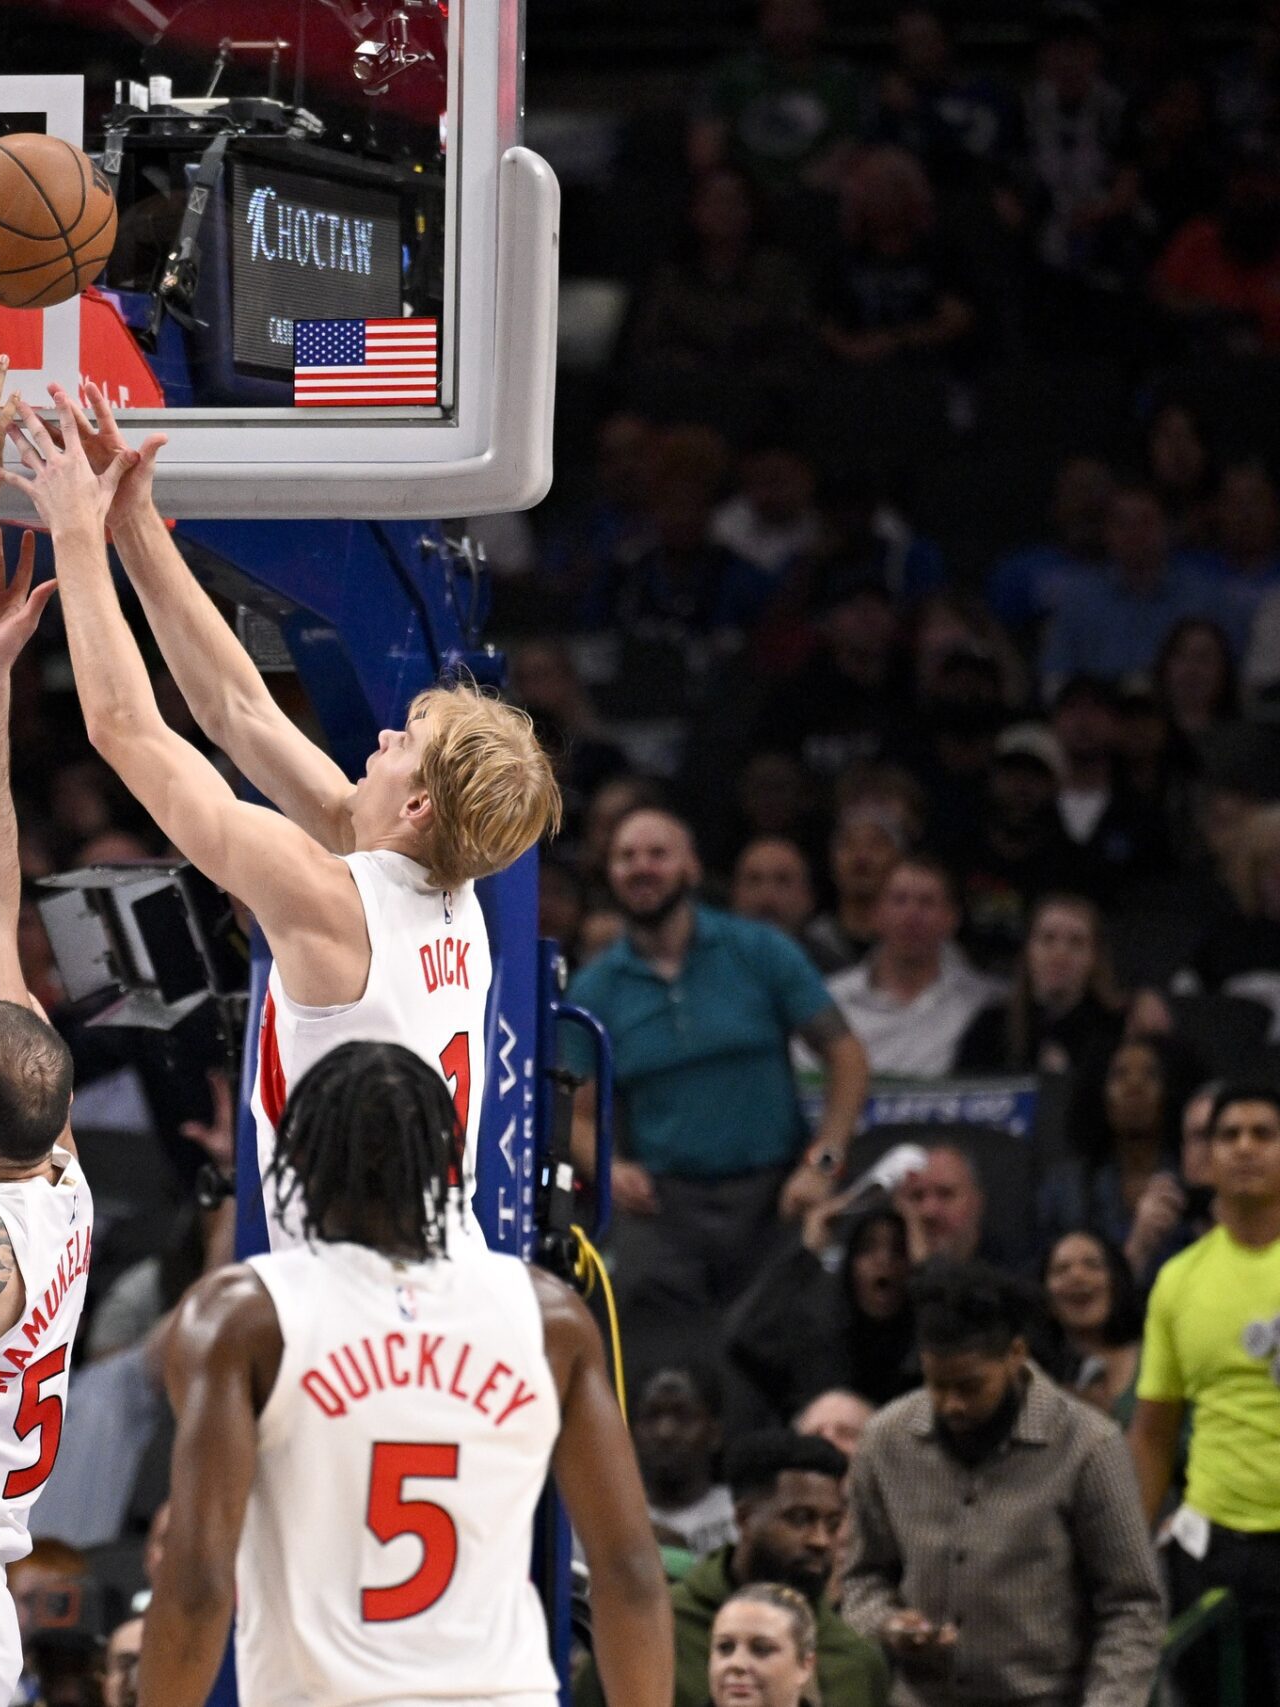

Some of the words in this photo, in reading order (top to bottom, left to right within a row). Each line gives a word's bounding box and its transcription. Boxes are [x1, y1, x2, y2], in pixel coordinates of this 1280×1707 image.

[246, 186, 373, 275] CHOCTAW
[419, 937, 470, 993] DICK
[498, 1014, 517, 1241] TAW
[2, 1342, 69, 1500] 5
[300, 1331, 537, 1427] QUICKLEY
[360, 1440, 460, 1623] 5
